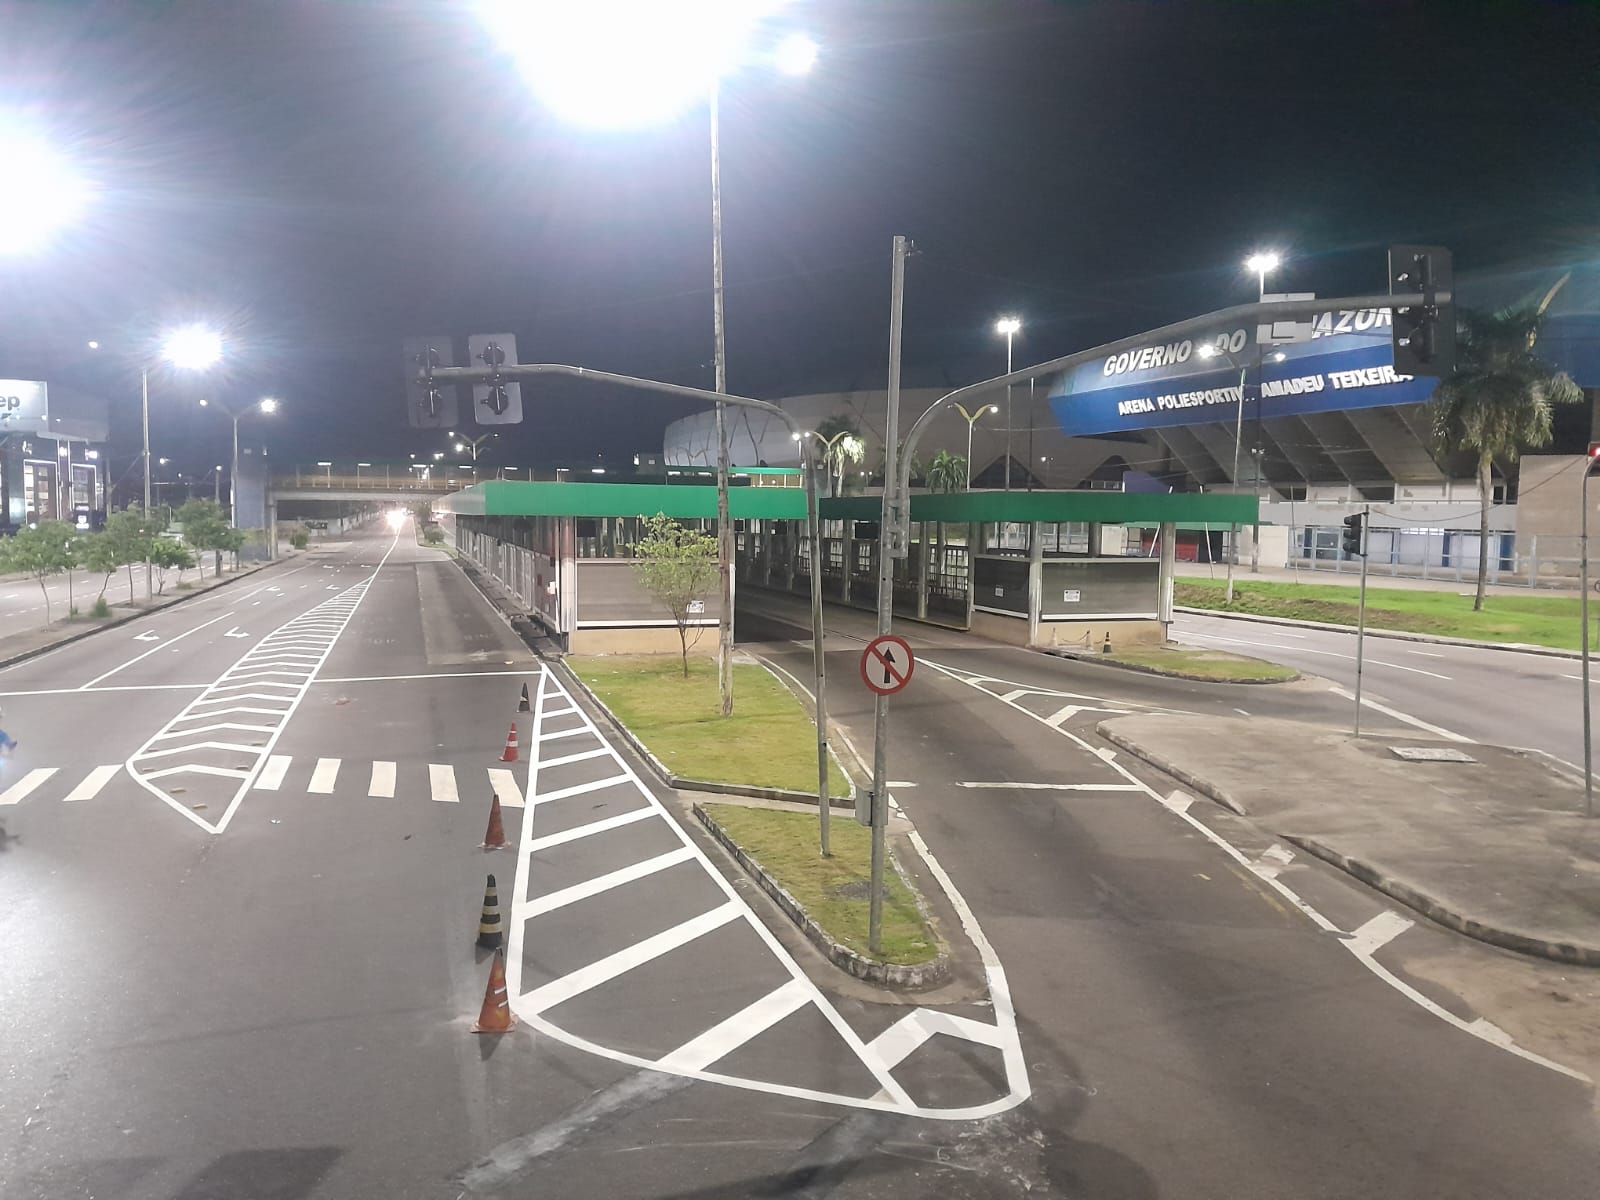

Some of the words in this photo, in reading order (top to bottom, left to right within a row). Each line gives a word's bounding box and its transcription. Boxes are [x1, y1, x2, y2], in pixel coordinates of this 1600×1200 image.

[1103, 340, 1192, 377] GOVERNO
[1214, 329, 1247, 356] DO
[1312, 307, 1393, 339] AZON
[1118, 398, 1156, 416] ARENA
[1157, 386, 1255, 411] POLIESPORTIV
[1261, 374, 1325, 398] AMADEU
